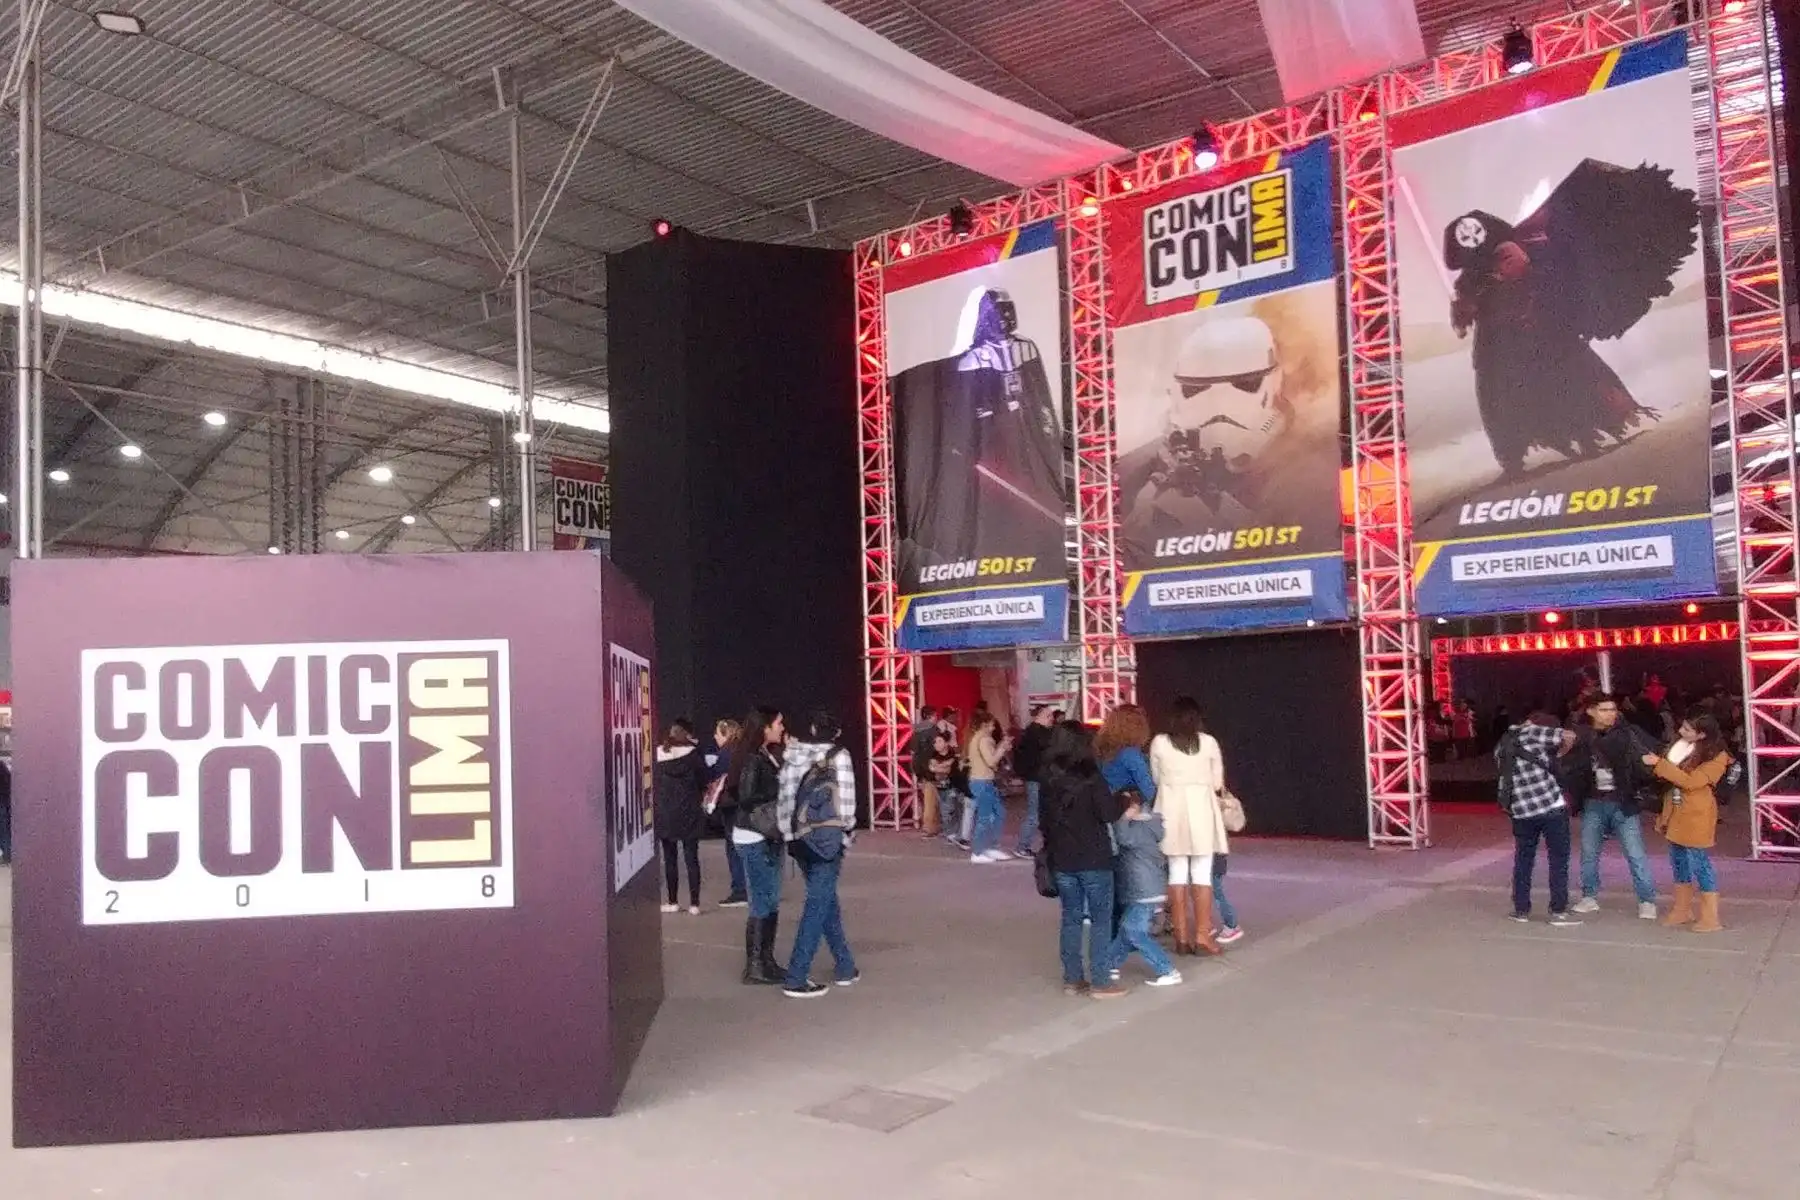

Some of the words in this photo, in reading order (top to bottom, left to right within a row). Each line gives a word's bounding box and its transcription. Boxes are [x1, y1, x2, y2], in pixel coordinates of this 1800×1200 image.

[1148, 185, 1246, 240] COMIC
[1250, 175, 1285, 262] LIMA
[1150, 218, 1247, 288] CON
[556, 479, 605, 503] COMIC
[1459, 489, 1564, 525] LEGIÓN
[557, 498, 605, 530] CON
[1155, 528, 1232, 557] LEGIÓN
[920, 557, 977, 583] LEGIÓN
[1463, 551, 1591, 576] EXPERIENCIA
[1597, 544, 1658, 564] ÚNICA
[1157, 581, 1252, 601] EXPERIENCIA
[1255, 577, 1301, 593] ÚNICA
[921, 605, 993, 622] EXPERIENCIA
[995, 600, 1036, 615] ÚNICA
[94, 653, 391, 743] COMIC
[409, 658, 492, 863] LIMA
[94, 741, 393, 881] CON
